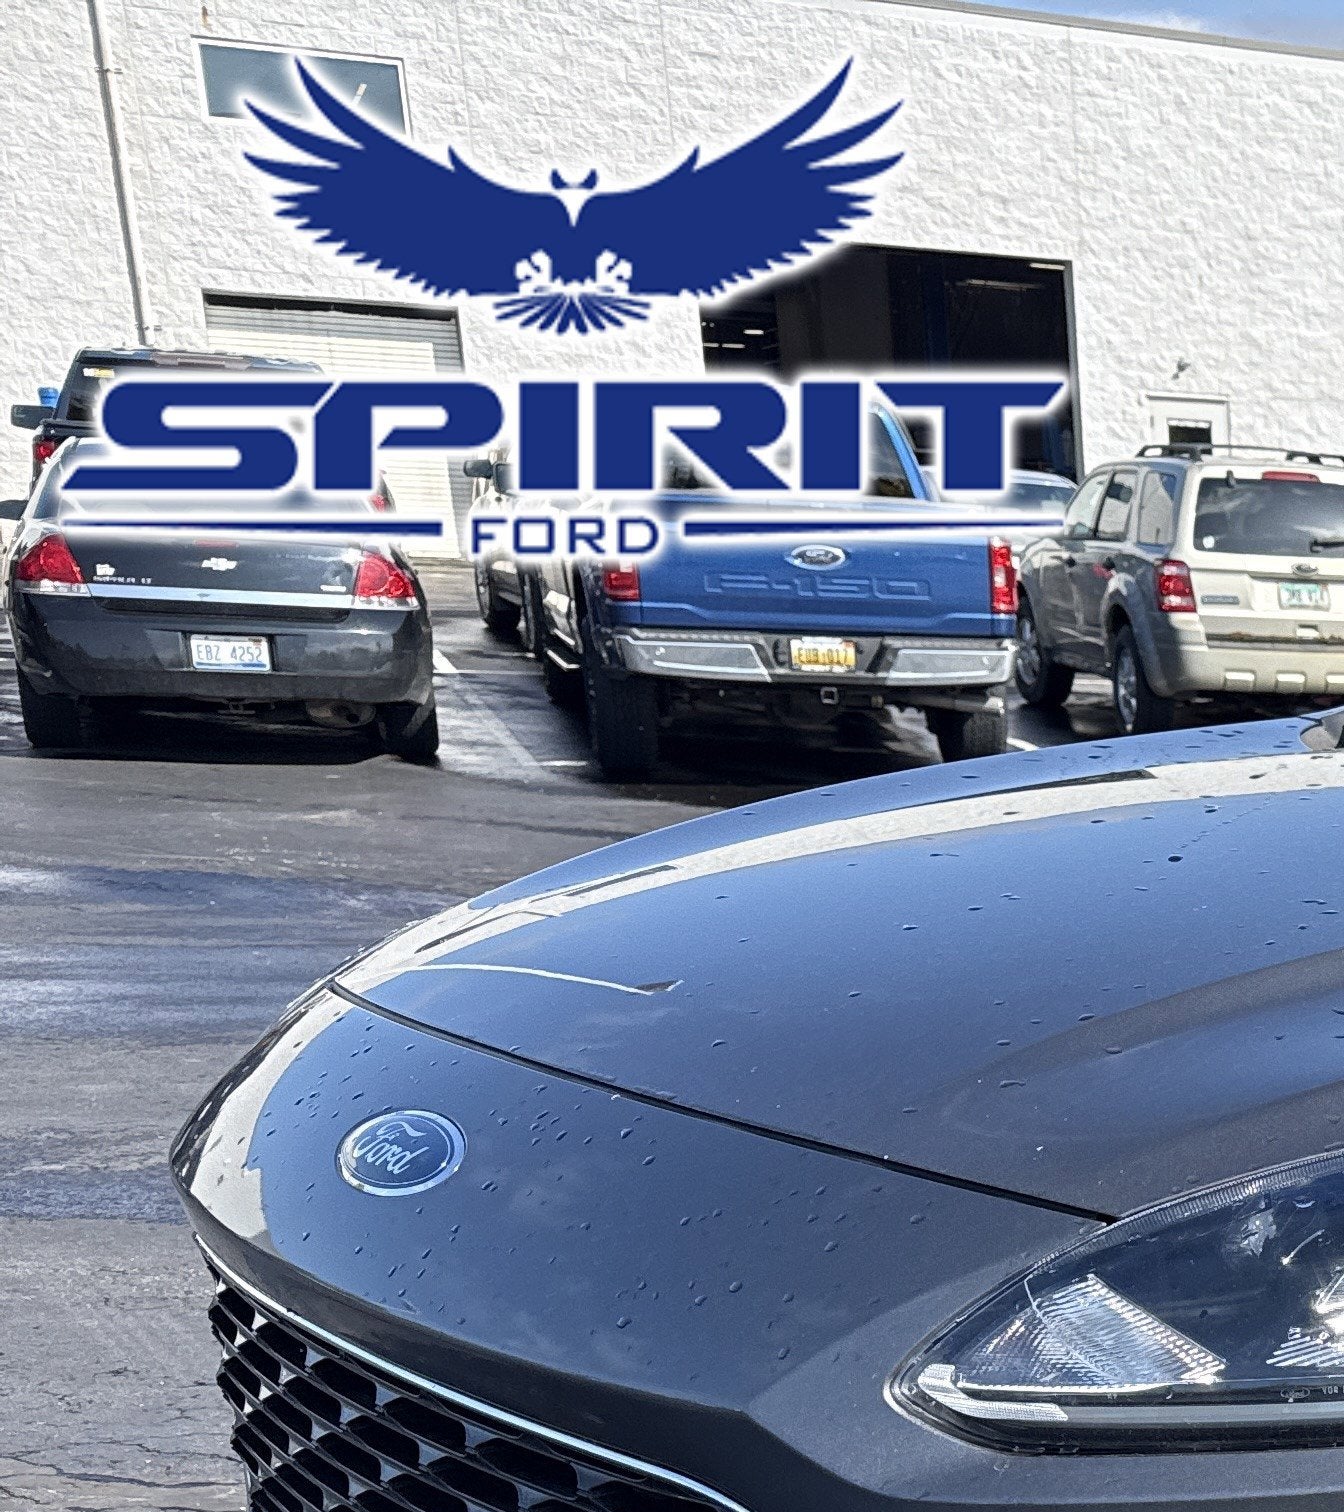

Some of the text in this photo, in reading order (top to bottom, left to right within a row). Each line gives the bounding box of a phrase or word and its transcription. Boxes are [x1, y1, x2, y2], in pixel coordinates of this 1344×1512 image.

[703, 573, 931, 601] F-150
[196, 644, 263, 663] EBZ 4252
[353, 1120, 430, 1175] Ford
